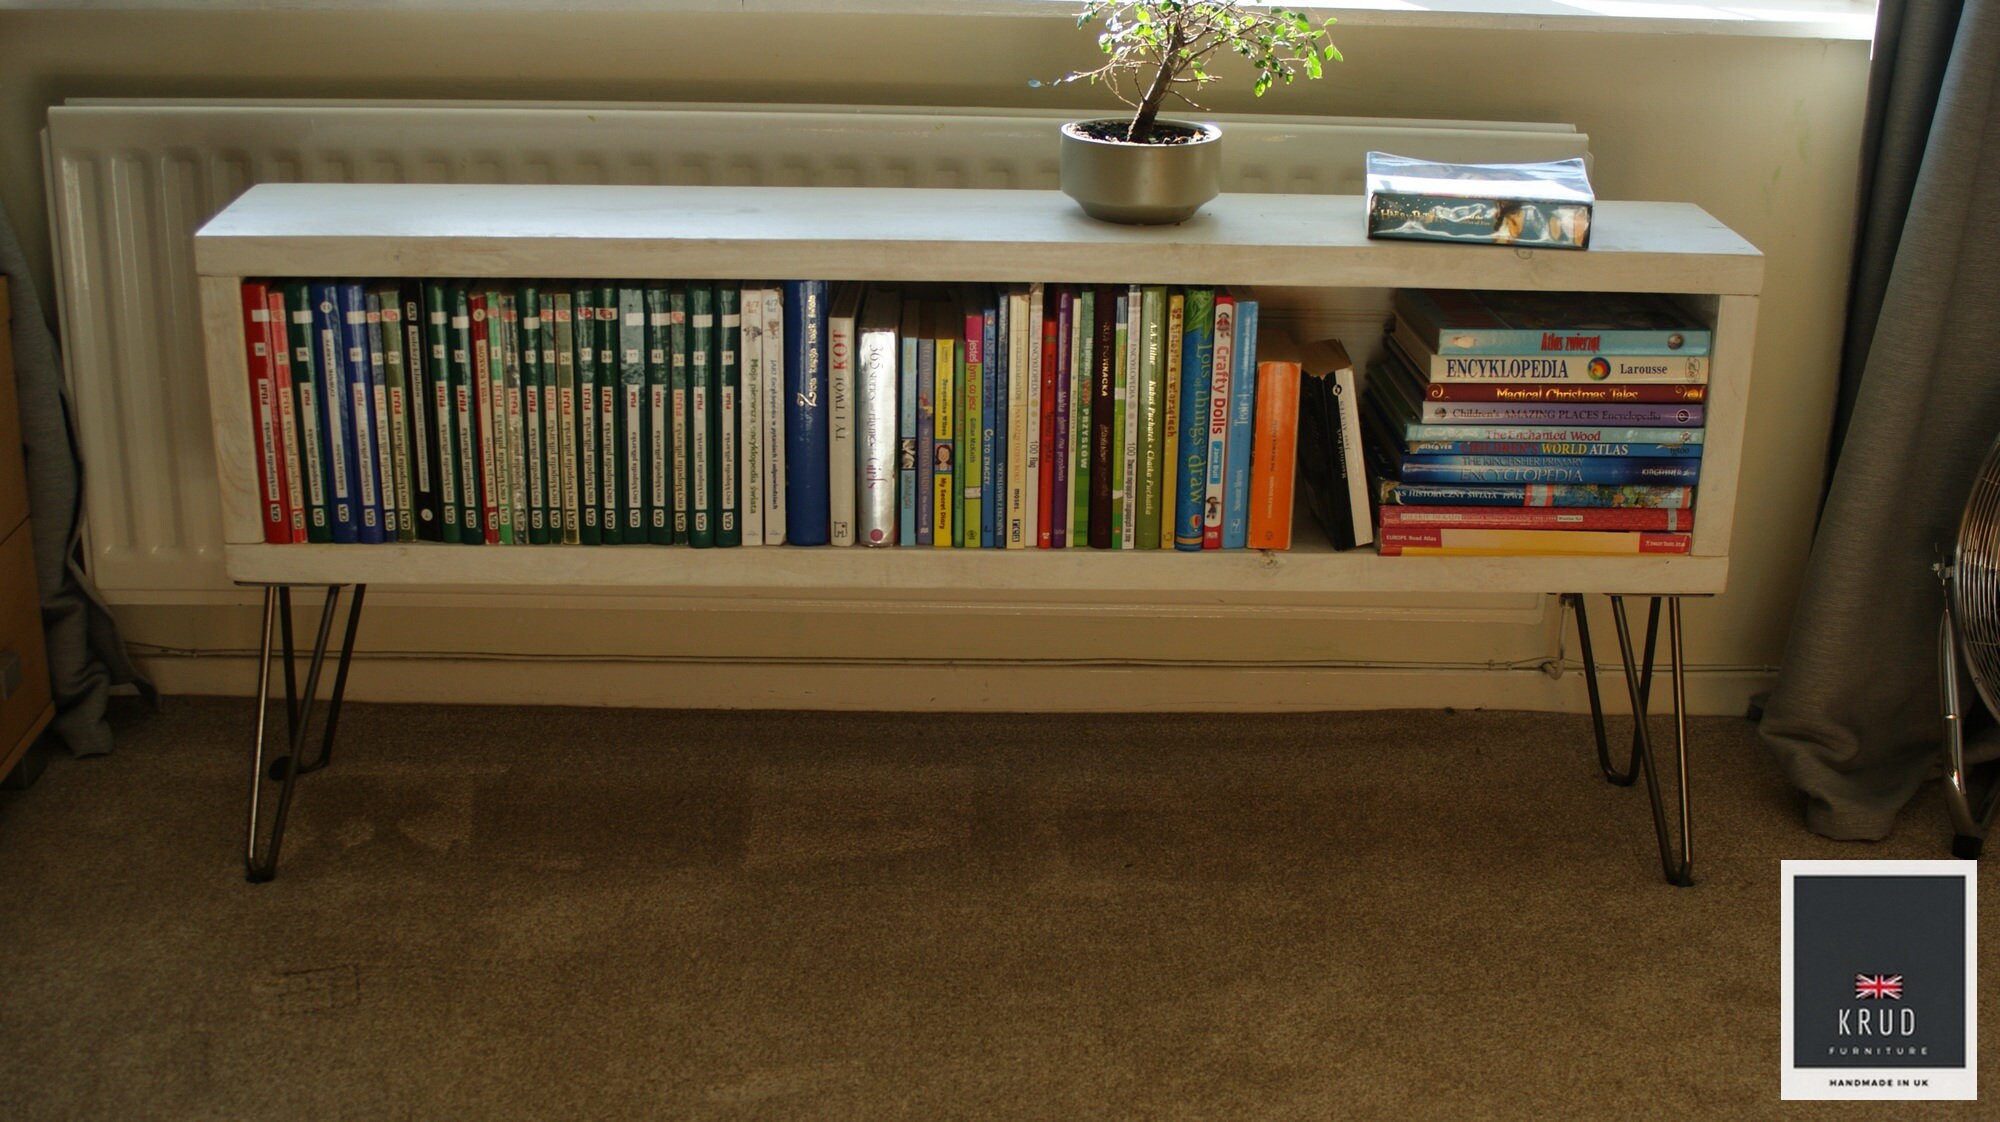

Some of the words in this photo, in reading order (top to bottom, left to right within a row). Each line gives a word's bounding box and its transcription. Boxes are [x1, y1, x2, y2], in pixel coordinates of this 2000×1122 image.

[1172, 308, 1182, 320] 52
[832, 329, 848, 370] KOT
[1540, 332, 1563, 351] Atlas
[1149, 342, 1158, 366] Milne
[1196, 344, 1213, 379] Lots
[1213, 345, 1229, 394] Crafty
[1446, 358, 1569, 379] ENCYKLOPEDIA
[1619, 363, 1668, 375] Larousse
[260, 383, 269, 405] FUJI
[356, 389, 364, 406] FUJI
[438, 386, 446, 407] FUJI
[494, 385, 502, 408] FUJI
[546, 388, 555, 411] FUJI
[583, 388, 591, 411] FUJI
[970, 385, 977, 394] co
[1496, 386, 1543, 401] Magical
[1546, 387, 1606, 401] Christmas
[1609, 387, 1639, 401] Tales
[282, 390, 291, 415] FUJI
[376, 390, 384, 411] FUJI
[393, 390, 401, 415] FUJI
[459, 390, 467, 413] FUJI
[563, 391, 571, 415] FUJI
[603, 390, 611, 413] FUJI
[968, 396, 978, 411] jesz
[1147, 407, 1157, 443] Puchatek
[1189, 390, 1210, 446] things
[1212, 397, 1227, 435] Dolls
[1452, 408, 1501, 419] Children's
[1504, 410, 1556, 420] AMAZING
[1558, 409, 1599, 420] PLACES
[1601, 410, 1661, 422] Encyclopedia
[835, 424, 846, 441] TY
[1485, 430, 1507, 441] The
[1508, 430, 1566, 441] Enchanted
[1570, 431, 1601, 442] Wood
[1030, 441, 1039, 454] 100
[1127, 442, 1136, 456] 100
[1460, 443, 1539, 455] CHILDREN'S
[1541, 443, 1588, 456] WORLD
[1589, 444, 1629, 456] ATLAS
[1146, 450, 1155, 479] Chatka
[1460, 468, 1584, 482] ENCYCLOPEDIA
[939, 478, 947, 488] My
[1188, 455, 1207, 505] draw
[1145, 480, 1155, 515] Puchatka
[938, 513, 947, 530] Diary
[1408, 534, 1423, 542] Road
[1424, 534, 1437, 542] Atlas
